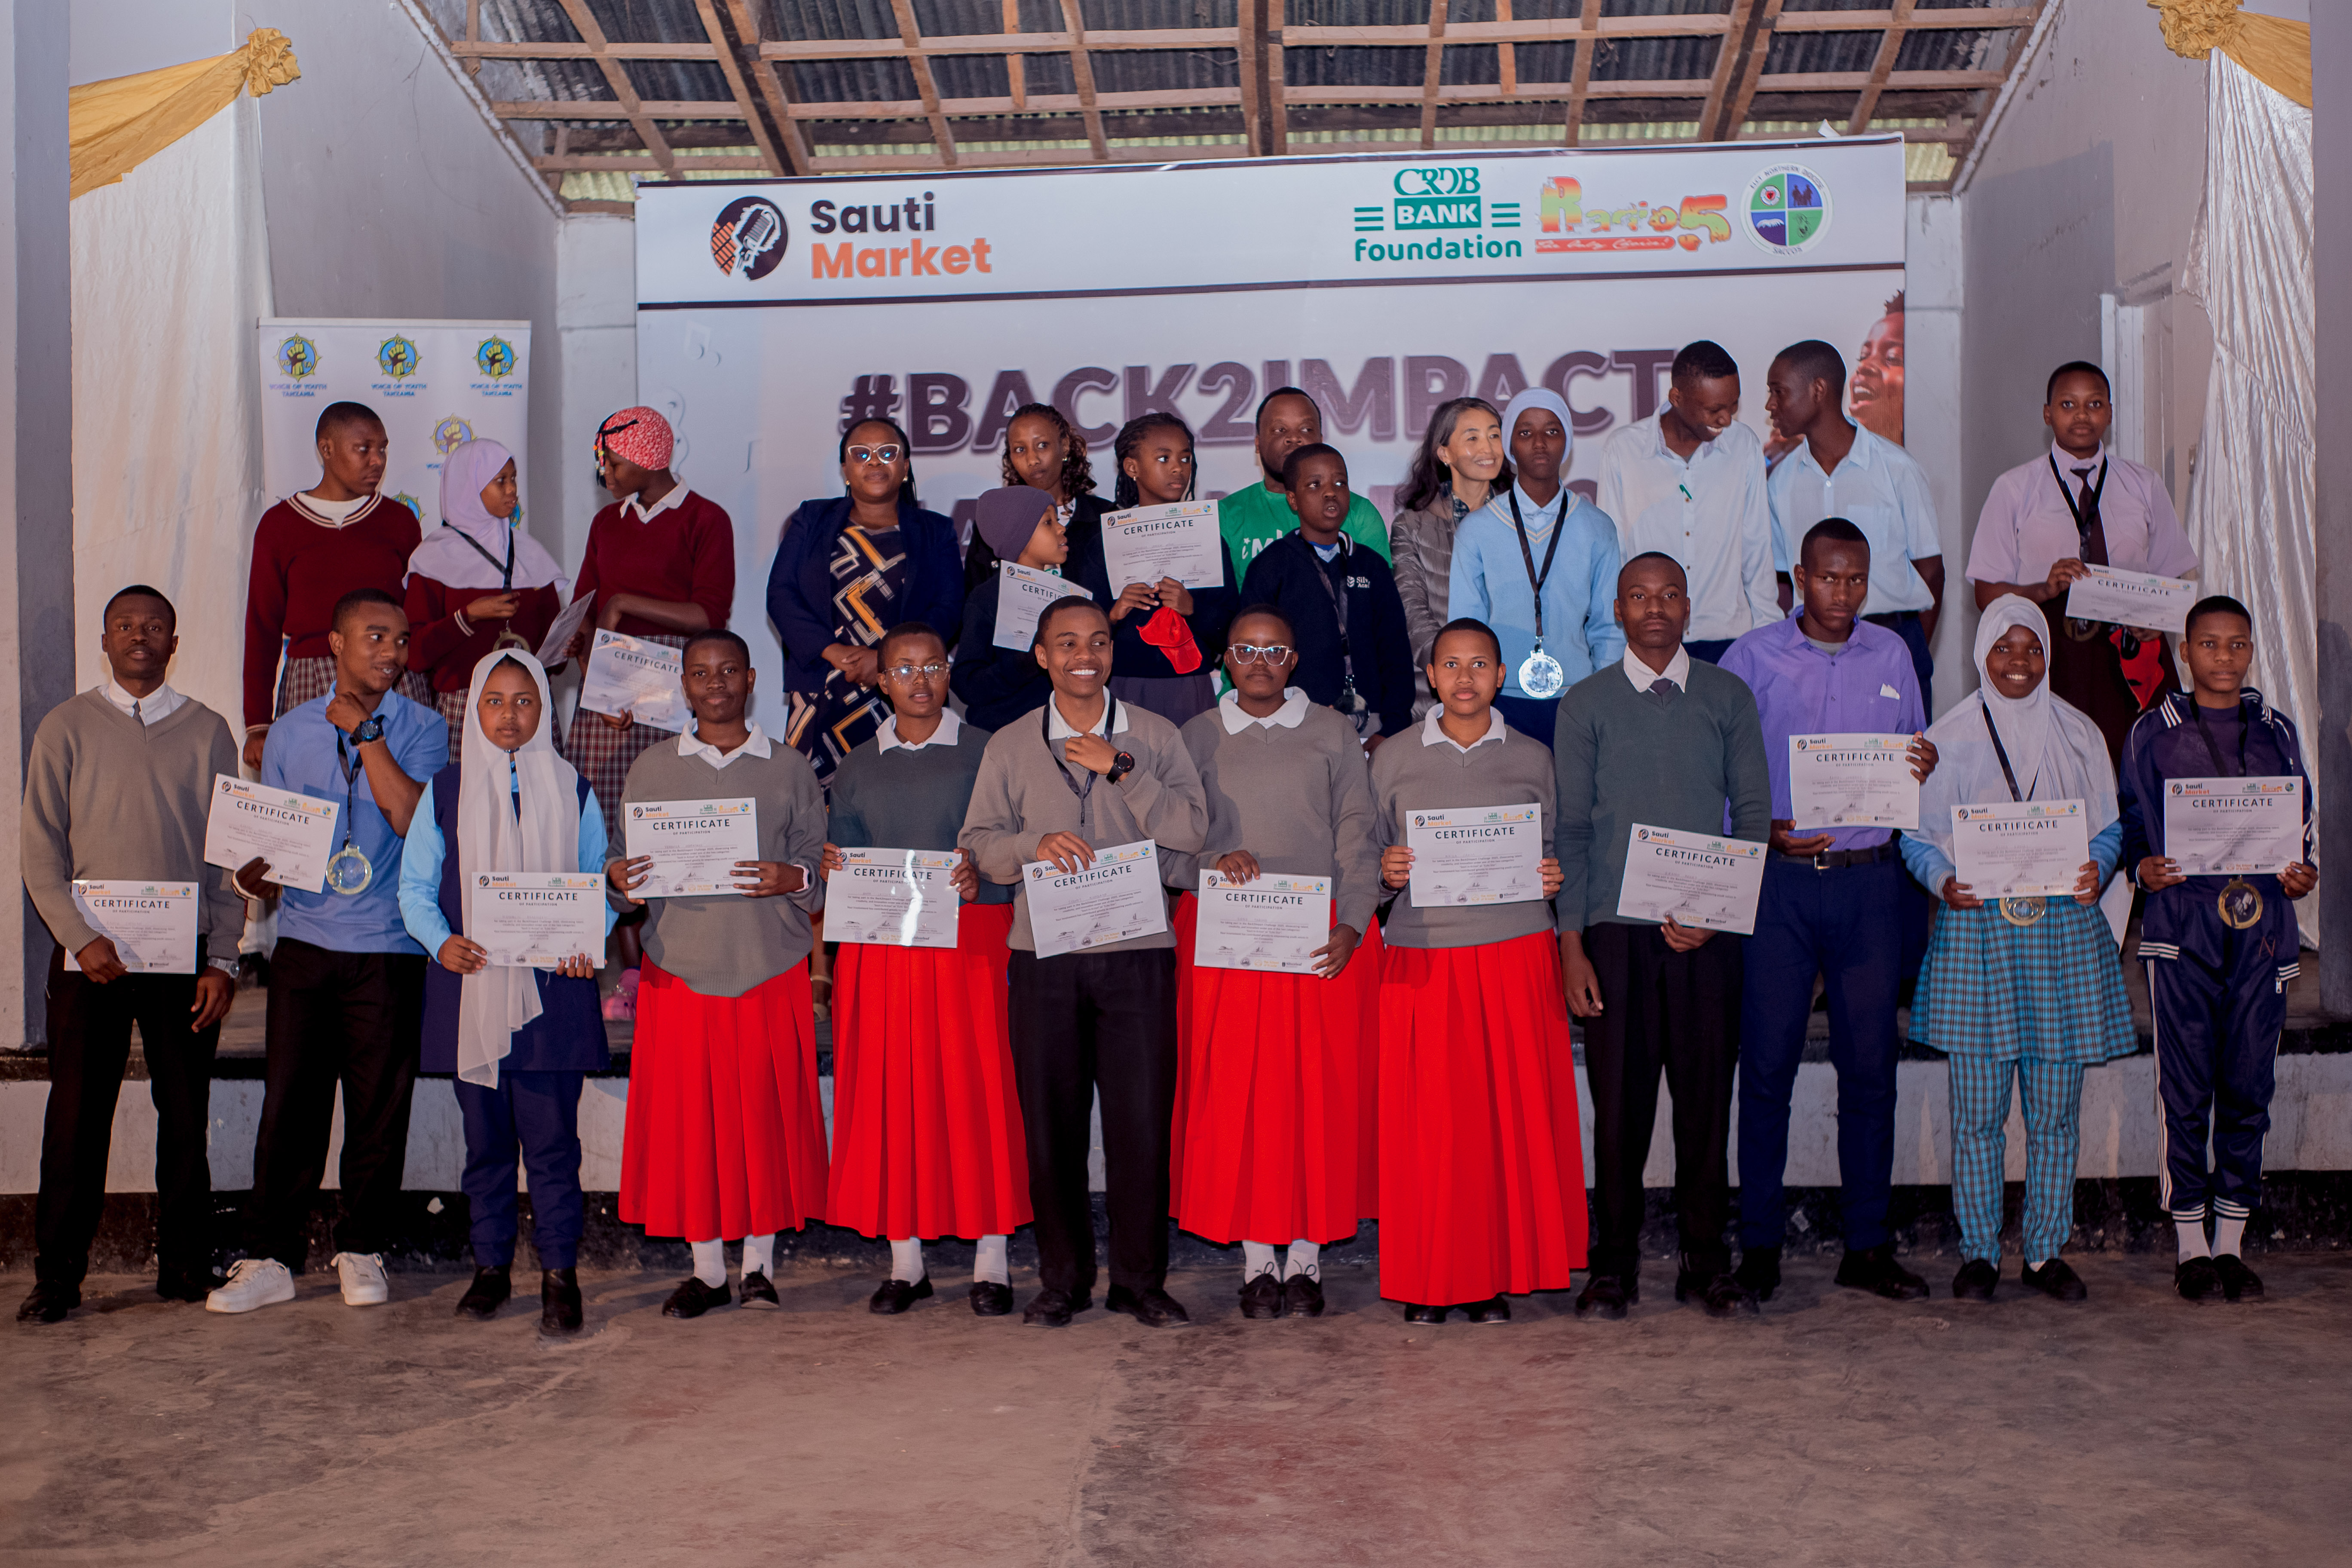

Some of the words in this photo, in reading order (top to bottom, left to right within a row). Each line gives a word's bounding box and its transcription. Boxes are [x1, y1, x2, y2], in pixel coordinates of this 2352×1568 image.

[1394, 166, 1481, 195] CRDB
[811, 191, 936, 234] Sauti
[1397, 203, 1479, 224] BANK
[1355, 234, 1522, 261] foundation
[811, 237, 992, 280] Market
[1124, 520, 1194, 535] CERTIFICATE
[1022, 584, 1063, 600] CERTIFI
[2098, 579, 2170, 596] CERTIFICATE
[614, 651, 679, 674] CERTIFICATE
[1816, 753, 1894, 762] CERTIFICATE
[234, 784, 250, 792] Sauti
[2192, 798, 2273, 808] CERTIFICATE
[236, 800, 310, 824] CERTIFICATE
[652, 818, 730, 830] CERTIFICATE
[1979, 819, 2058, 832] CERTIFICATE
[1435, 827, 1515, 839] CERTIFICATE
[1656, 847, 1736, 867] CERTIFICATE
[854, 868, 932, 880] CERTIFICATE
[1054, 864, 1132, 888] CERTIFICATE
[1082, 879, 1113, 888] PARTICIPATION
[499, 891, 578, 901] CERTIFICATE
[1225, 893, 1303, 905] CERTIFICATE
[94, 899, 171, 909] CERTIFICATE
